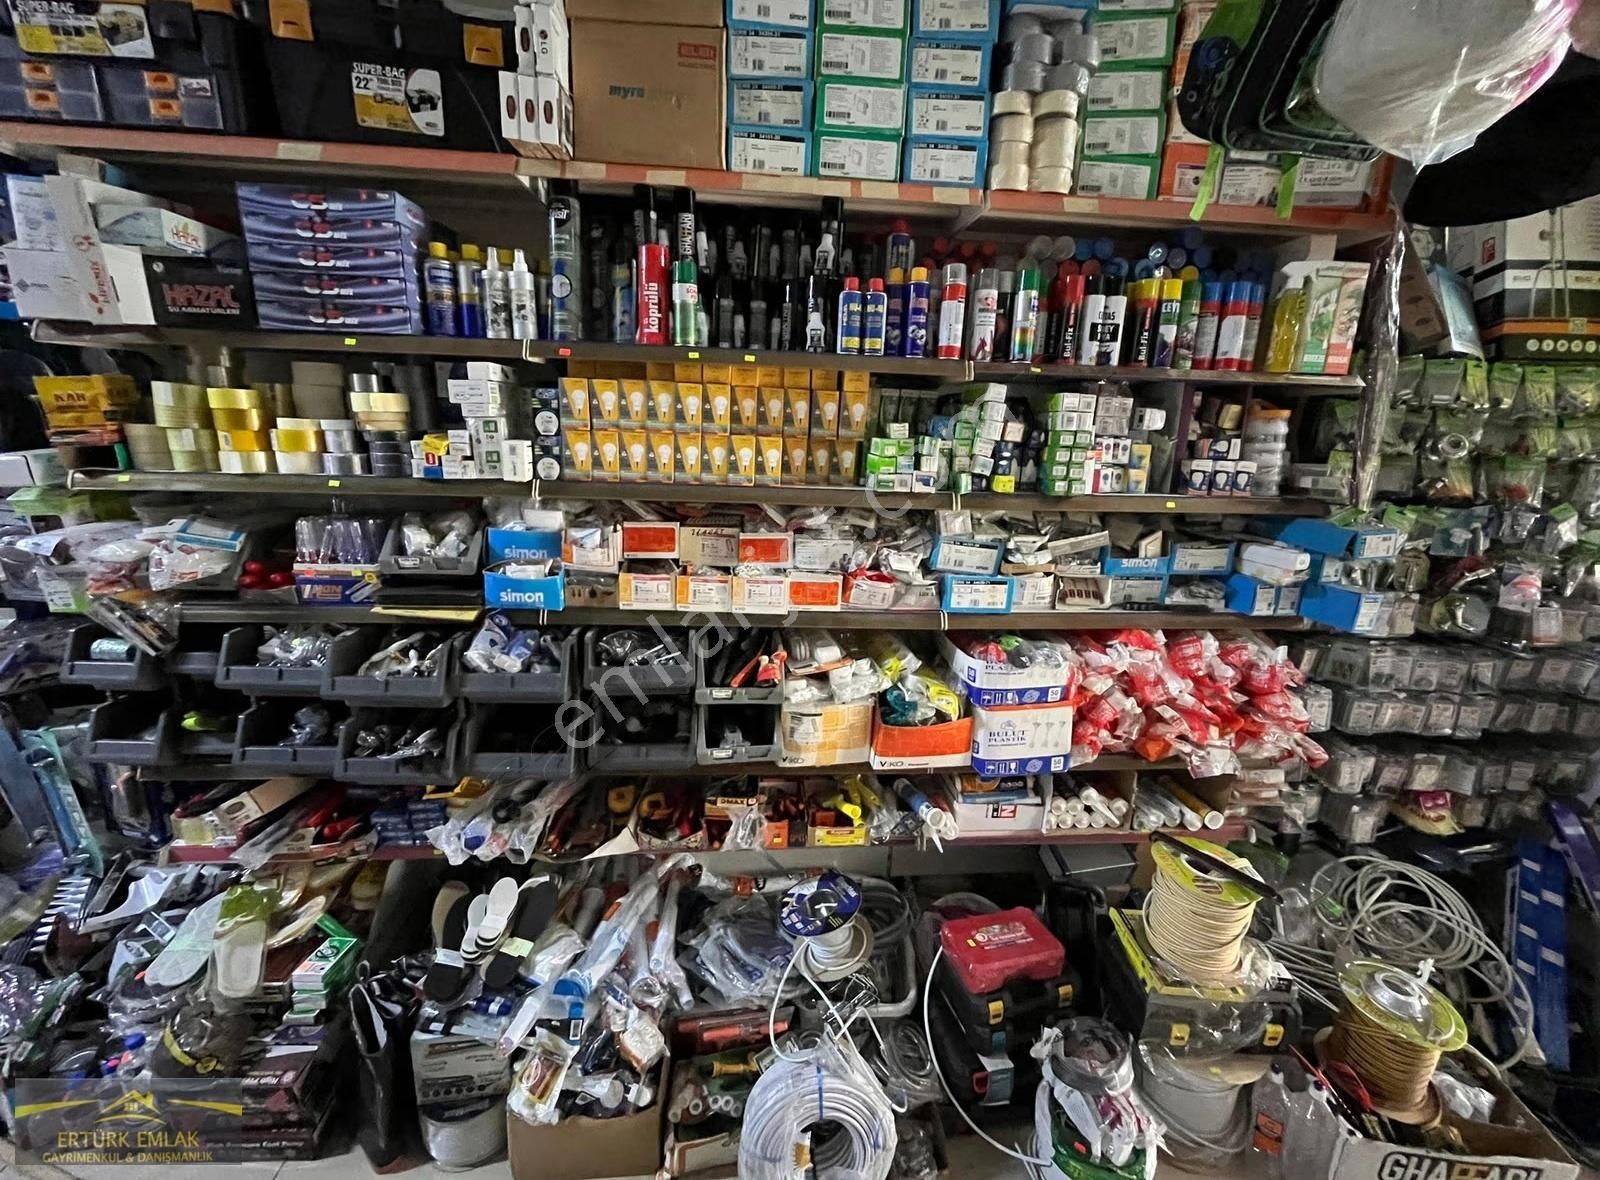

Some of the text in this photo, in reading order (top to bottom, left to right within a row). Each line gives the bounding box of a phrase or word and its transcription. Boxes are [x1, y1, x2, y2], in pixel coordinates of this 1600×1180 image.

[540, 41, 549, 55] LG
[353, 62, 406, 79] SUPER-BAG
[161, 283, 240, 308] HAZAL
[643, 282, 660, 334] köprülü
[1063, 327, 1075, 358] Bul-Fix
[1137, 330, 1149, 362] Bul-Fix
[504, 544, 548, 560] simon
[1120, 558, 1159, 569] simon
[499, 588, 545, 603] simon
[1050, 689, 1062, 698] 50
[1053, 759, 1063, 767] 50
